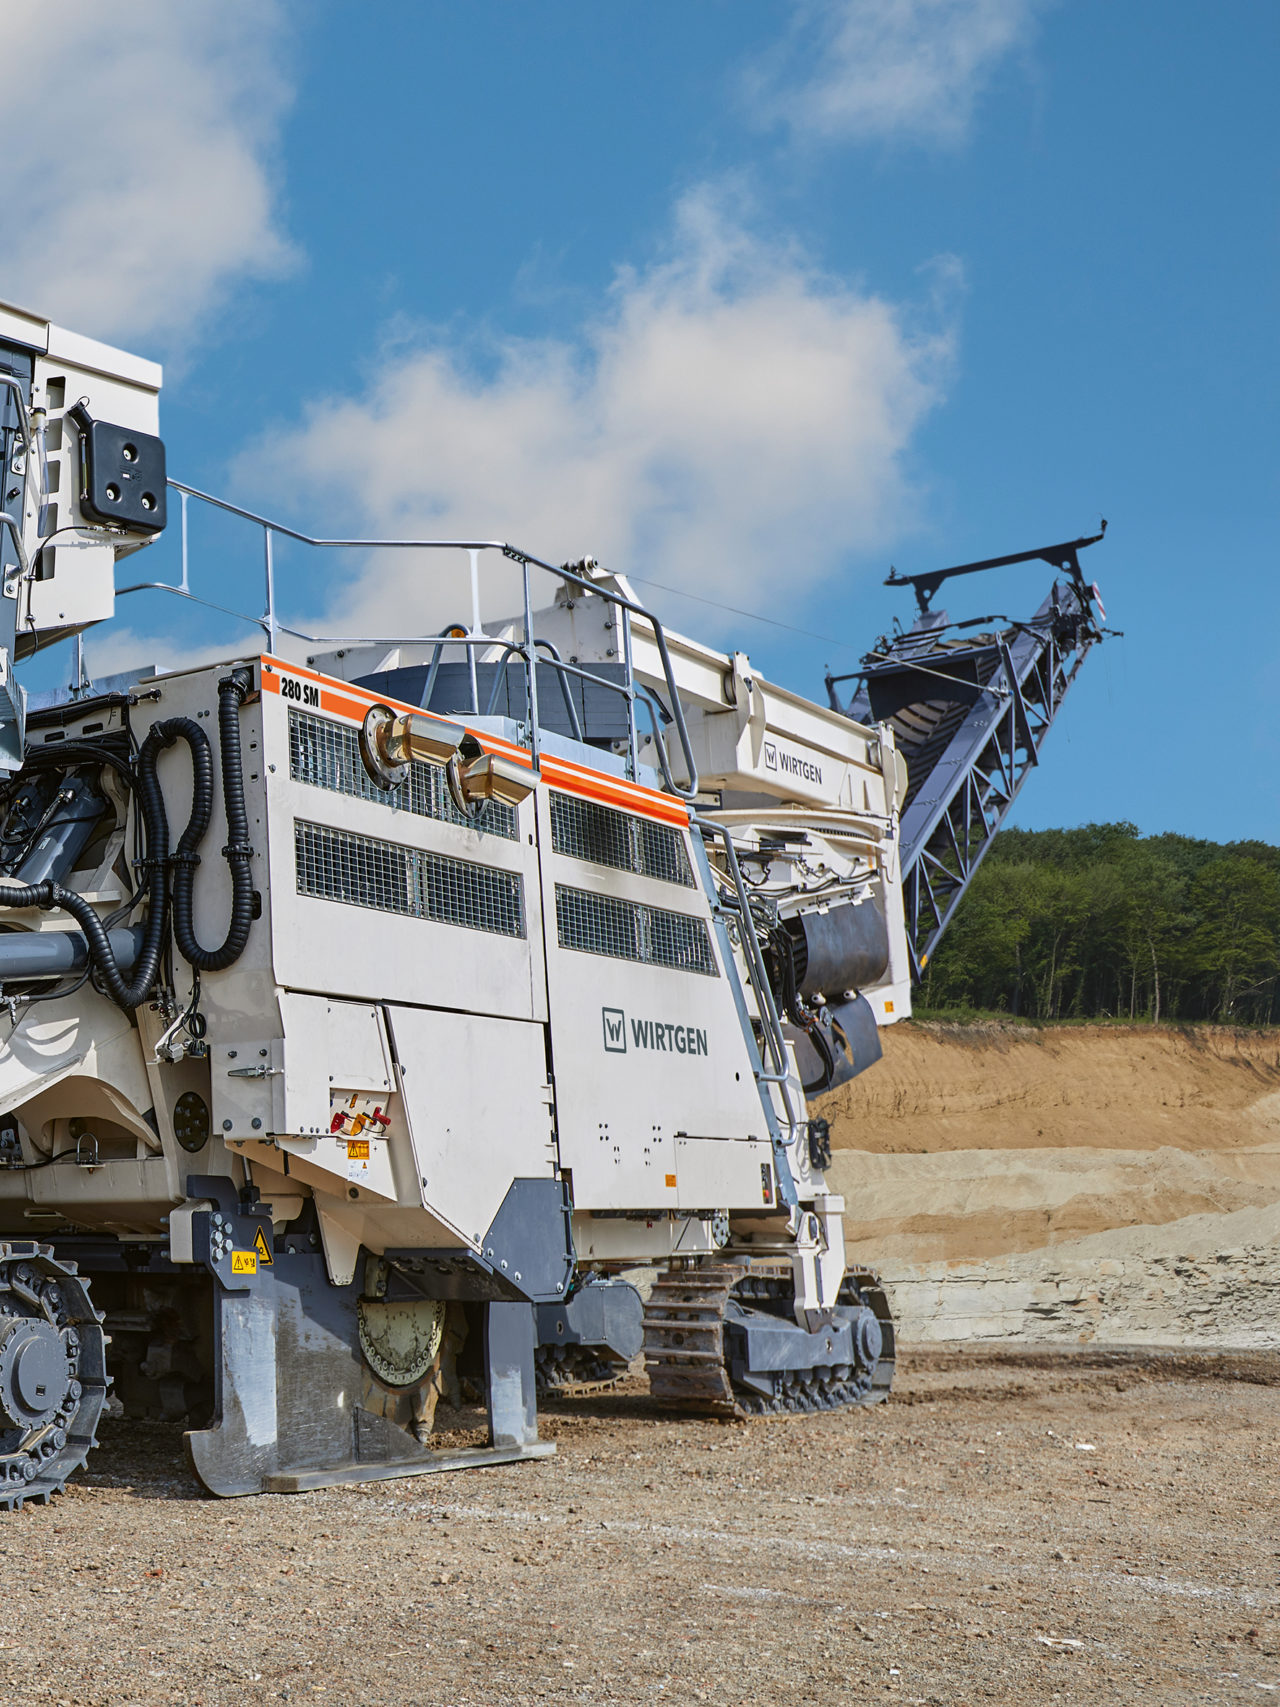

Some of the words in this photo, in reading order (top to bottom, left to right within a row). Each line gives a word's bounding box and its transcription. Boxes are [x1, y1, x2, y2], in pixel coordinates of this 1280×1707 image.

[281, 677, 301, 701] 280
[303, 684, 319, 707] SM
[779, 751, 822, 785] WIRTGEN
[631, 1018, 708, 1056] WIRTGEN
